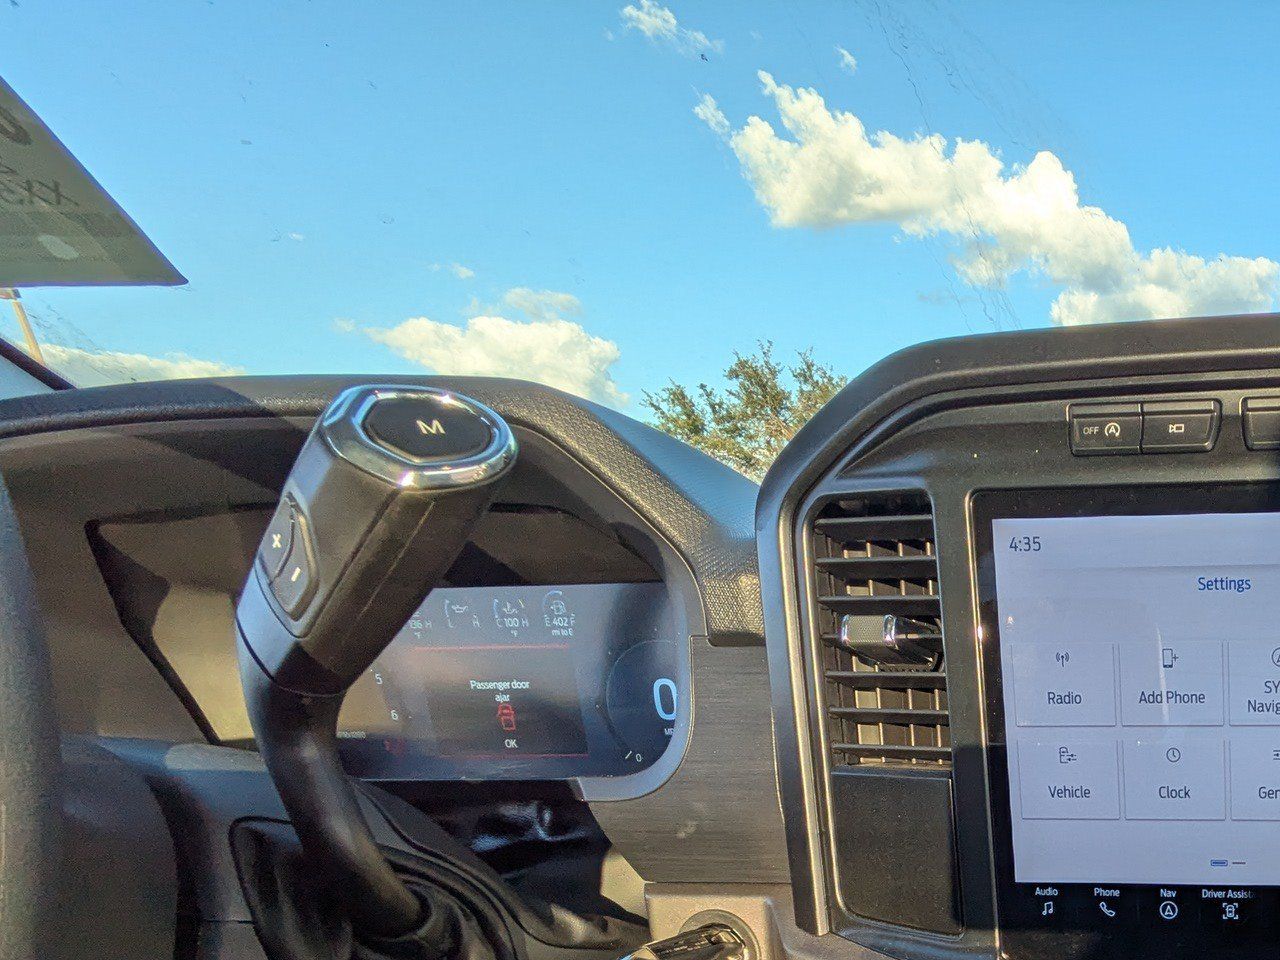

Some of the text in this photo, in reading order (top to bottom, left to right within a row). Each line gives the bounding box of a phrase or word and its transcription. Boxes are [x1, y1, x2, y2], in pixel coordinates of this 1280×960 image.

[416, 419, 446, 435] M
[1083, 426, 1099, 435] OFF
[1009, 536, 1042, 552] 4:35
[1197, 577, 1252, 593] Settings
[504, 617, 519, 628] 100
[552, 616, 569, 627] 402
[374, 673, 383, 685] 5
[470, 680, 530, 691] Passenger door
[495, 693, 510, 703] ajar
[653, 678, 678, 720] 0
[1047, 691, 1082, 705] Radio
[1138, 690, 1206, 704] Add Phone
[390, 709, 399, 721] 6
[504, 738, 518, 748] OK
[636, 753, 643, 762] 0
[1048, 785, 1091, 799] Vehicle
[1158, 785, 1191, 799] Clock
[1035, 887, 1058, 897] Audio
[1094, 888, 1120, 898] Phone
[1160, 889, 1177, 898] Nav
[1202, 889, 1226, 899] Driver
